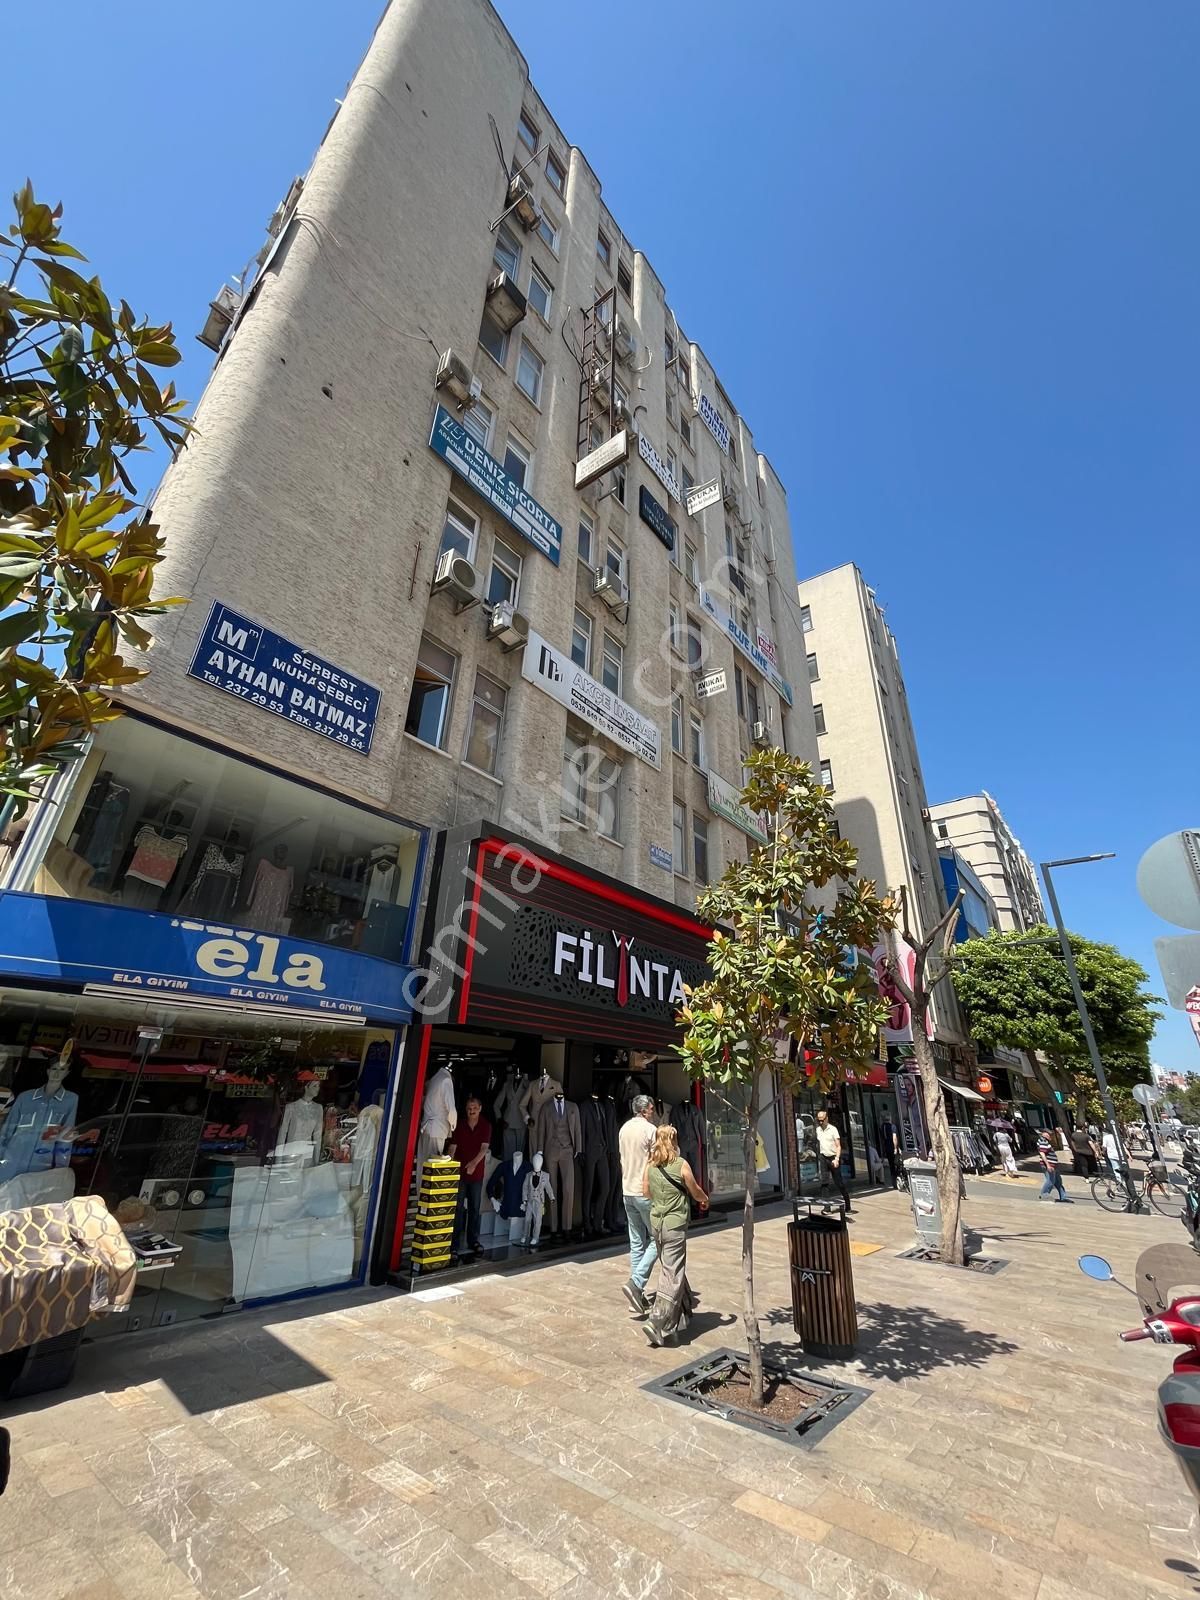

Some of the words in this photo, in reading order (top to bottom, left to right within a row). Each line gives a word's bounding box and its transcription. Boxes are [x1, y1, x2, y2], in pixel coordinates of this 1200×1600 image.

[687, 484, 718, 504] AVUKAT
[729, 619, 749, 650] BLUE
[751, 645, 768, 671] LINE
[292, 653, 357, 692] SERBEST
[698, 675, 723, 690] AVUKAT
[208, 650, 286, 698] AYHAN
[290, 687, 367, 738] BATMAZ
[573, 673, 611, 710] AKÇE
[203, 670, 221, 686] Tel.
[225, 681, 249, 696] 237
[251, 692, 267, 705] 29
[269, 700, 284, 713] 53
[289, 710, 312, 727] Fax.
[315, 721, 334, 737] 237
[336, 732, 348, 743] 29
[350, 738, 363, 750] 54
[196, 935, 327, 991] ela
[112, 973, 143, 985] ELA
[229, 987, 254, 999] ELA
[319, 1000, 337, 1009] ELA
[203, 1124, 249, 1139] ELA
